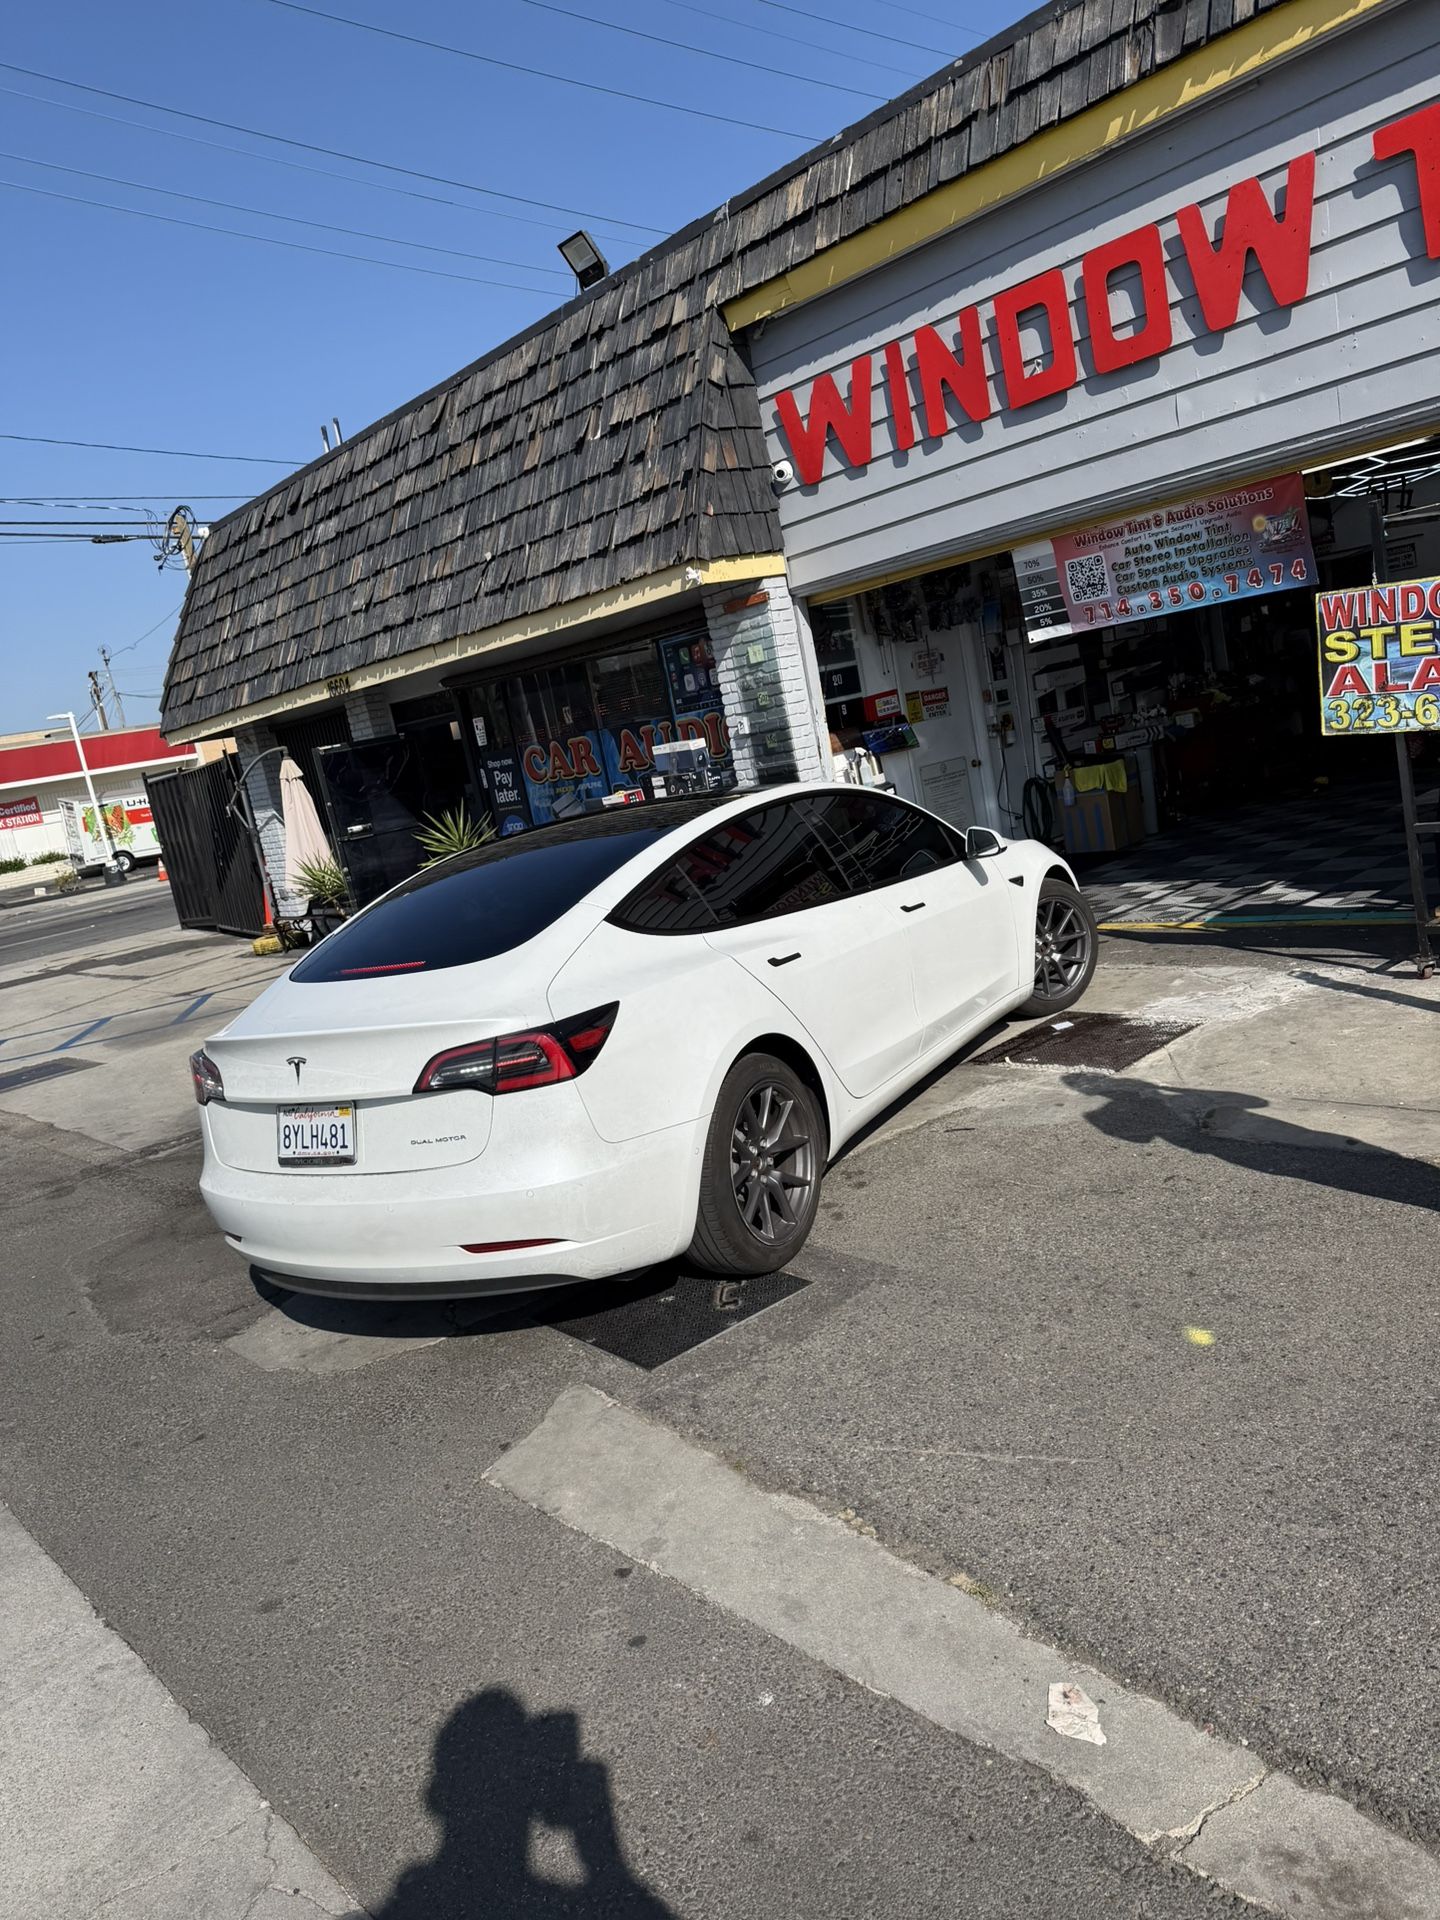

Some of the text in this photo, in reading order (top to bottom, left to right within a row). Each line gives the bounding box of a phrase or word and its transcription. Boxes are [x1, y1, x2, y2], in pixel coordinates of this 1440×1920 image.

[775, 150, 1316, 486] WINDOW
[1073, 488, 1274, 548] Window Tint & Audio Solutions
[1098, 509, 1242, 551] Enhance Comfort Improve Security Upgrade Audio
[1125, 522, 1231, 557] Auto Window Tint
[1111, 561, 1131, 572] Car
[1133, 551, 1171, 567] Stereo
[1174, 532, 1250, 557] Installation
[1024, 559, 1040, 569] 70%
[1115, 572, 1135, 583] Car
[1137, 560, 1186, 578] Speaker
[1188, 545, 1251, 567] Upgrades
[1027, 574, 1044, 585] 50%
[1117, 558, 1255, 595] Custom Audio Systems
[1031, 588, 1048, 598] 35%
[1034, 602, 1052, 614] 20%
[1039, 617, 1053, 627] 5%
[1324, 620, 1437, 664] STE
[1327, 655, 1440, 699] ALA
[923, 690, 947, 701] DANGER
[929, 710, 947, 718] ENTER
[935, 703, 947, 711] NOT
[1328, 694, 1440, 730] 323-6
[523, 711, 731, 784] CAR AUDI
[487, 758, 514, 769] Shop now.
[493, 770, 513, 788] Pay
[126, 798, 150, 807] U-H
[495, 788, 521, 804] later.
[0, 801, 37, 816] Certified
[6, 812, 40, 827] STATION
[294, 1107, 339, 1122] California
[283, 1123, 348, 1149] 8YLH481
[410, 1134, 467, 1146] DUAL MOTOR
